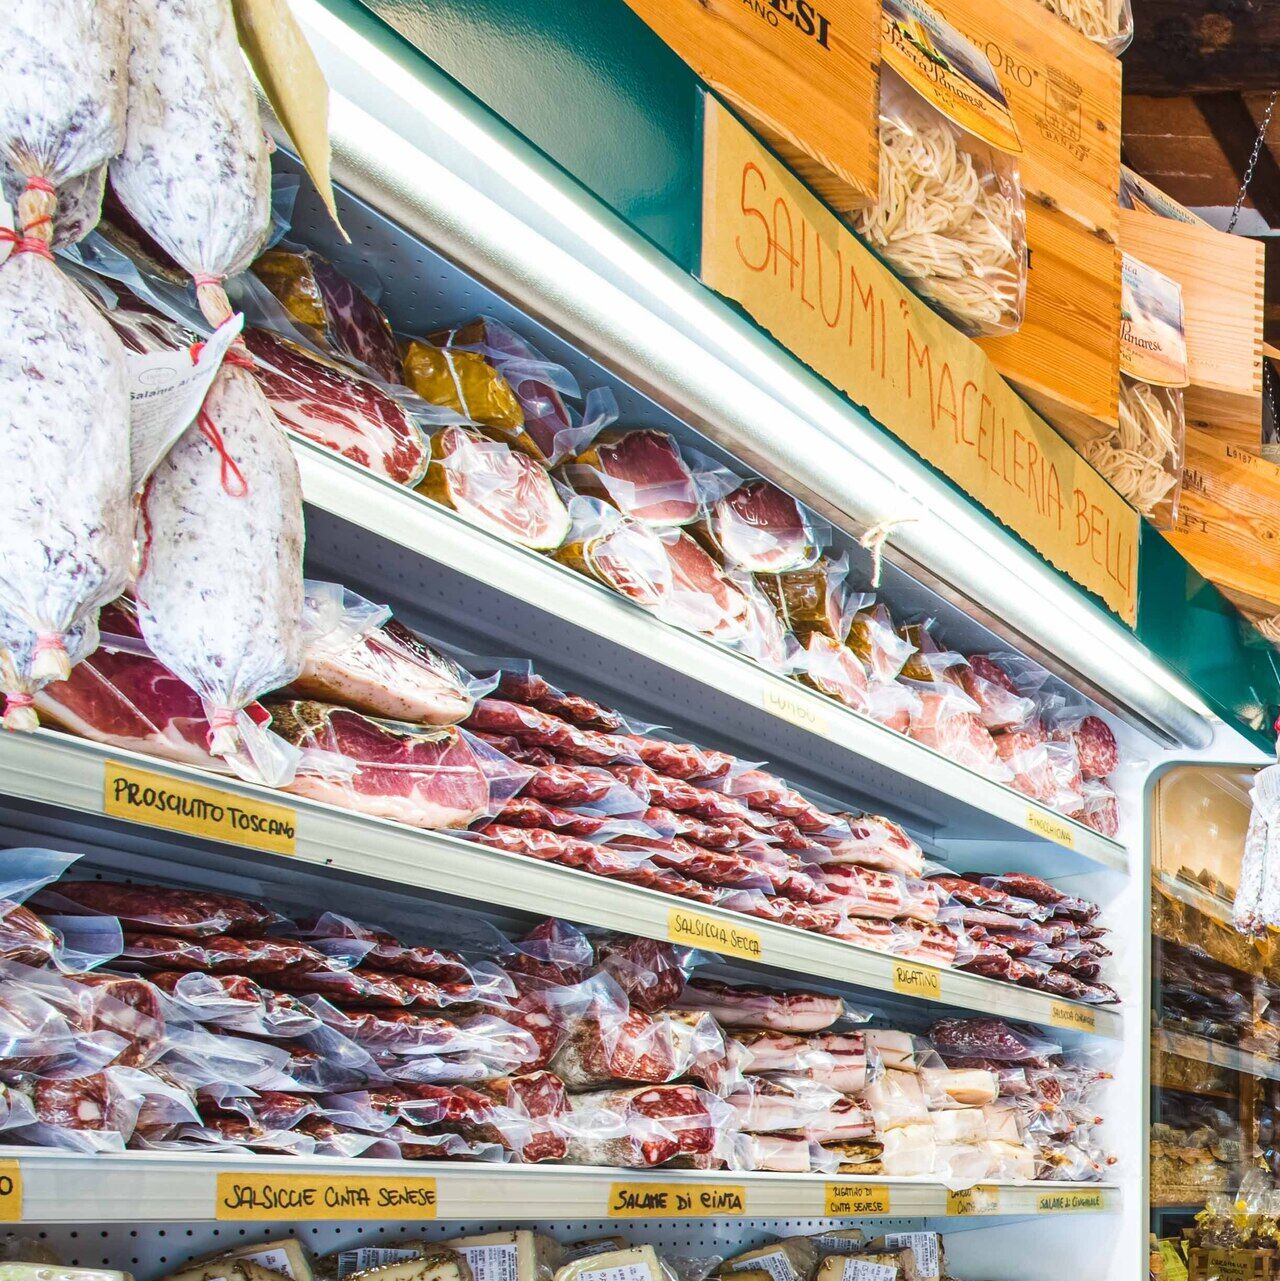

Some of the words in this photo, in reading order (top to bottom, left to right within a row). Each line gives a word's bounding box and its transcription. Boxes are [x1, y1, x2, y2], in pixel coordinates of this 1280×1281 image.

[926, 61, 988, 111] Panarese
[736, 161, 888, 379] SALUMI
[907, 327, 1064, 522] MACELLERIA
[114, 777, 225, 823] PROSCIUTTO
[226, 806, 296, 840] TOSCANO
[674, 916, 729, 944] SALSICCIA
[730, 929, 761, 956] SECCA
[897, 966, 939, 990] RIGATINO
[223, 1187, 318, 1211] SALSICCIE
[324, 1188, 371, 1208] CINTA
[377, 1185, 437, 1207] SENESE
[830, 1202, 851, 1213] CINTA
[853, 1202, 884, 1213] SENESE
[832, 1186, 863, 1198] RIGATINO
[864, 1186, 873, 1197] DI
